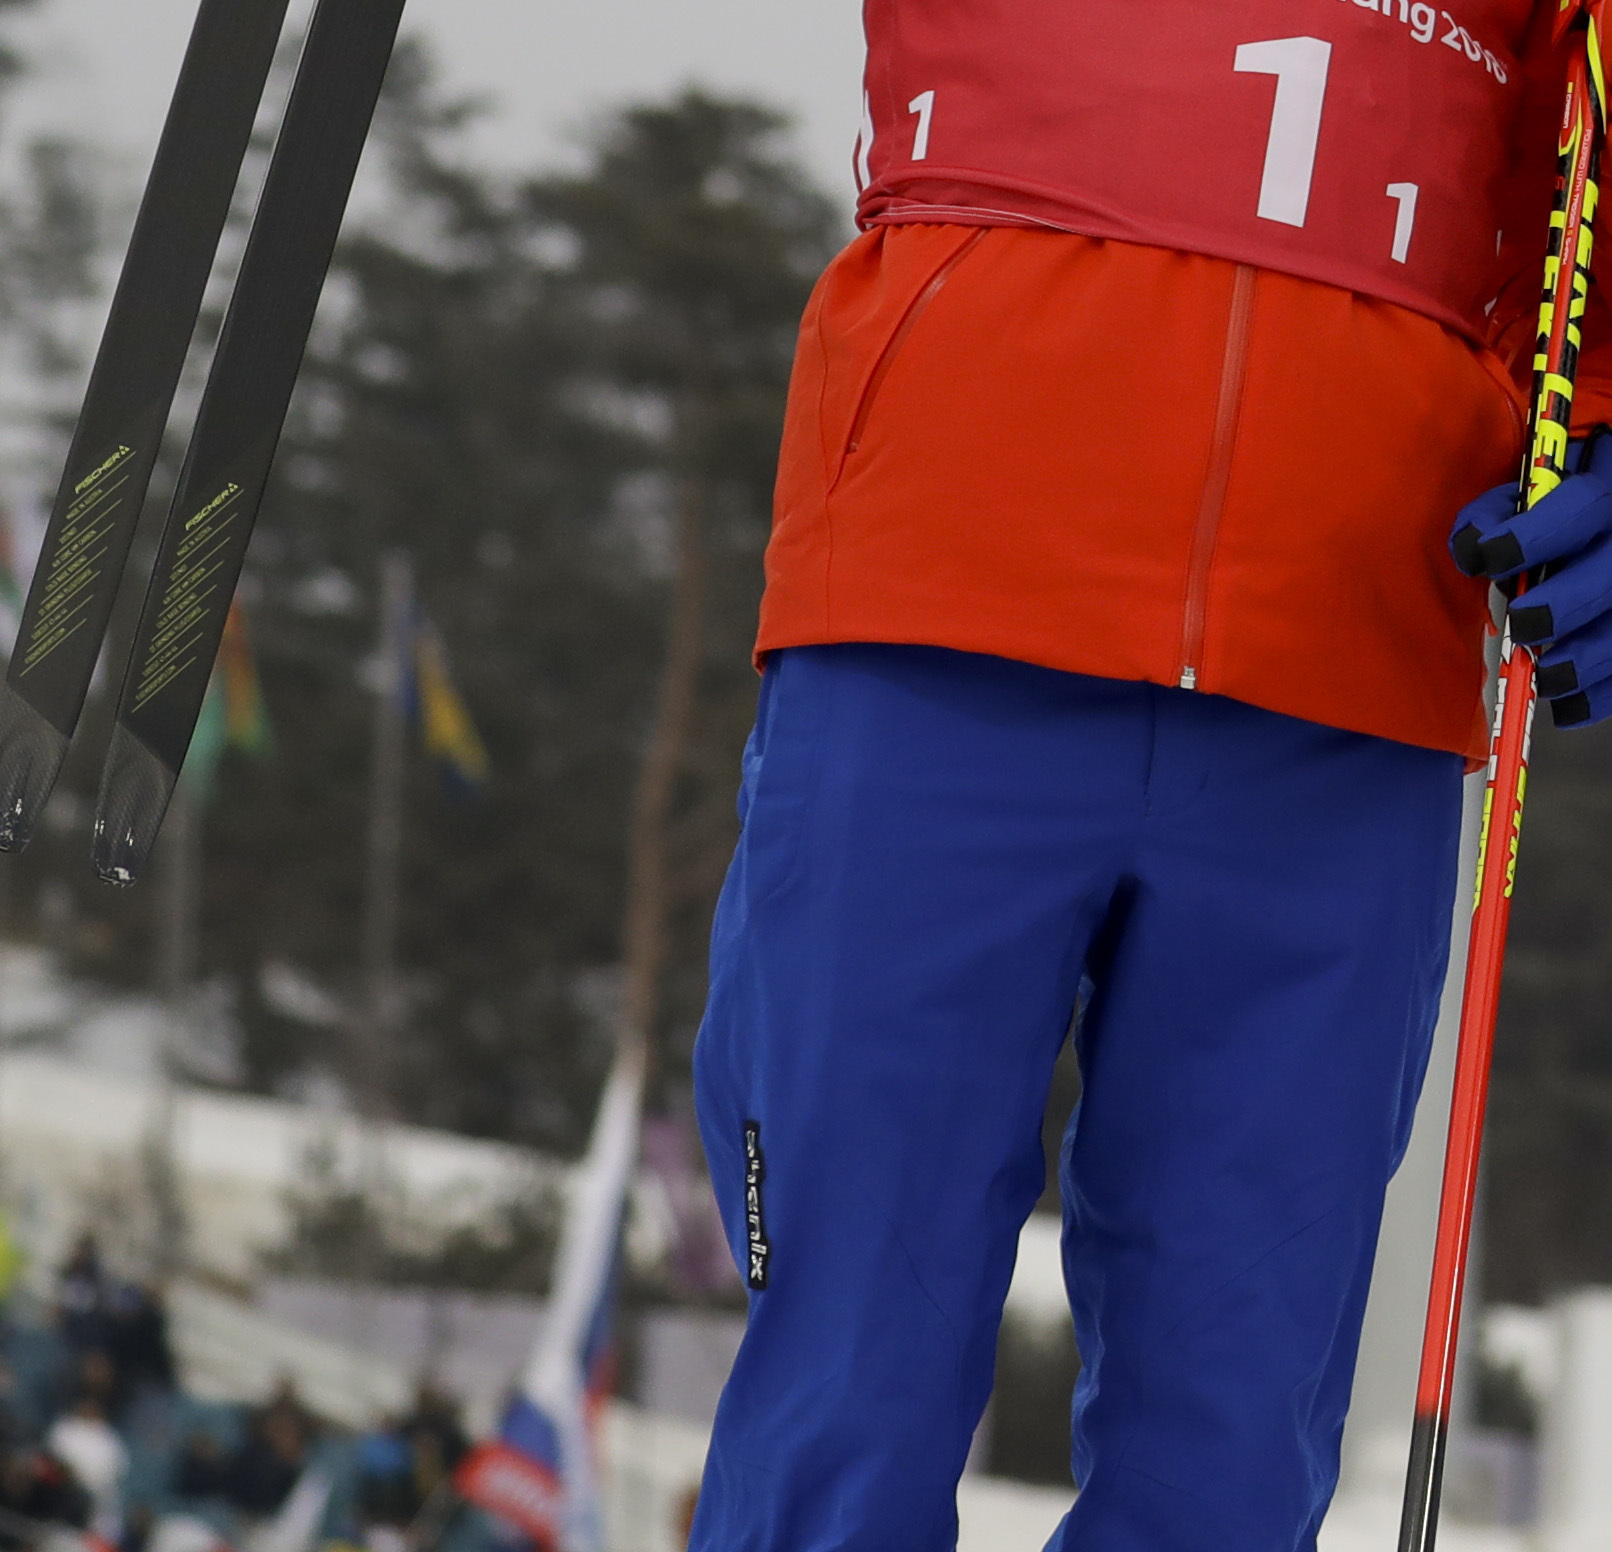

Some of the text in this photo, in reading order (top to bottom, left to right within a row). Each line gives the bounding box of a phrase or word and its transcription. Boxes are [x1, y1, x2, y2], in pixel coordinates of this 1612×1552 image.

[907, 90, 935, 161] 1
[1233, 36, 1332, 229] 1
[1386, 182, 1418, 264] 1
[73, 451, 122, 495] FISCHER
[1527, 372, 1573, 511] LEK
[184, 488, 231, 532] FISCHER
